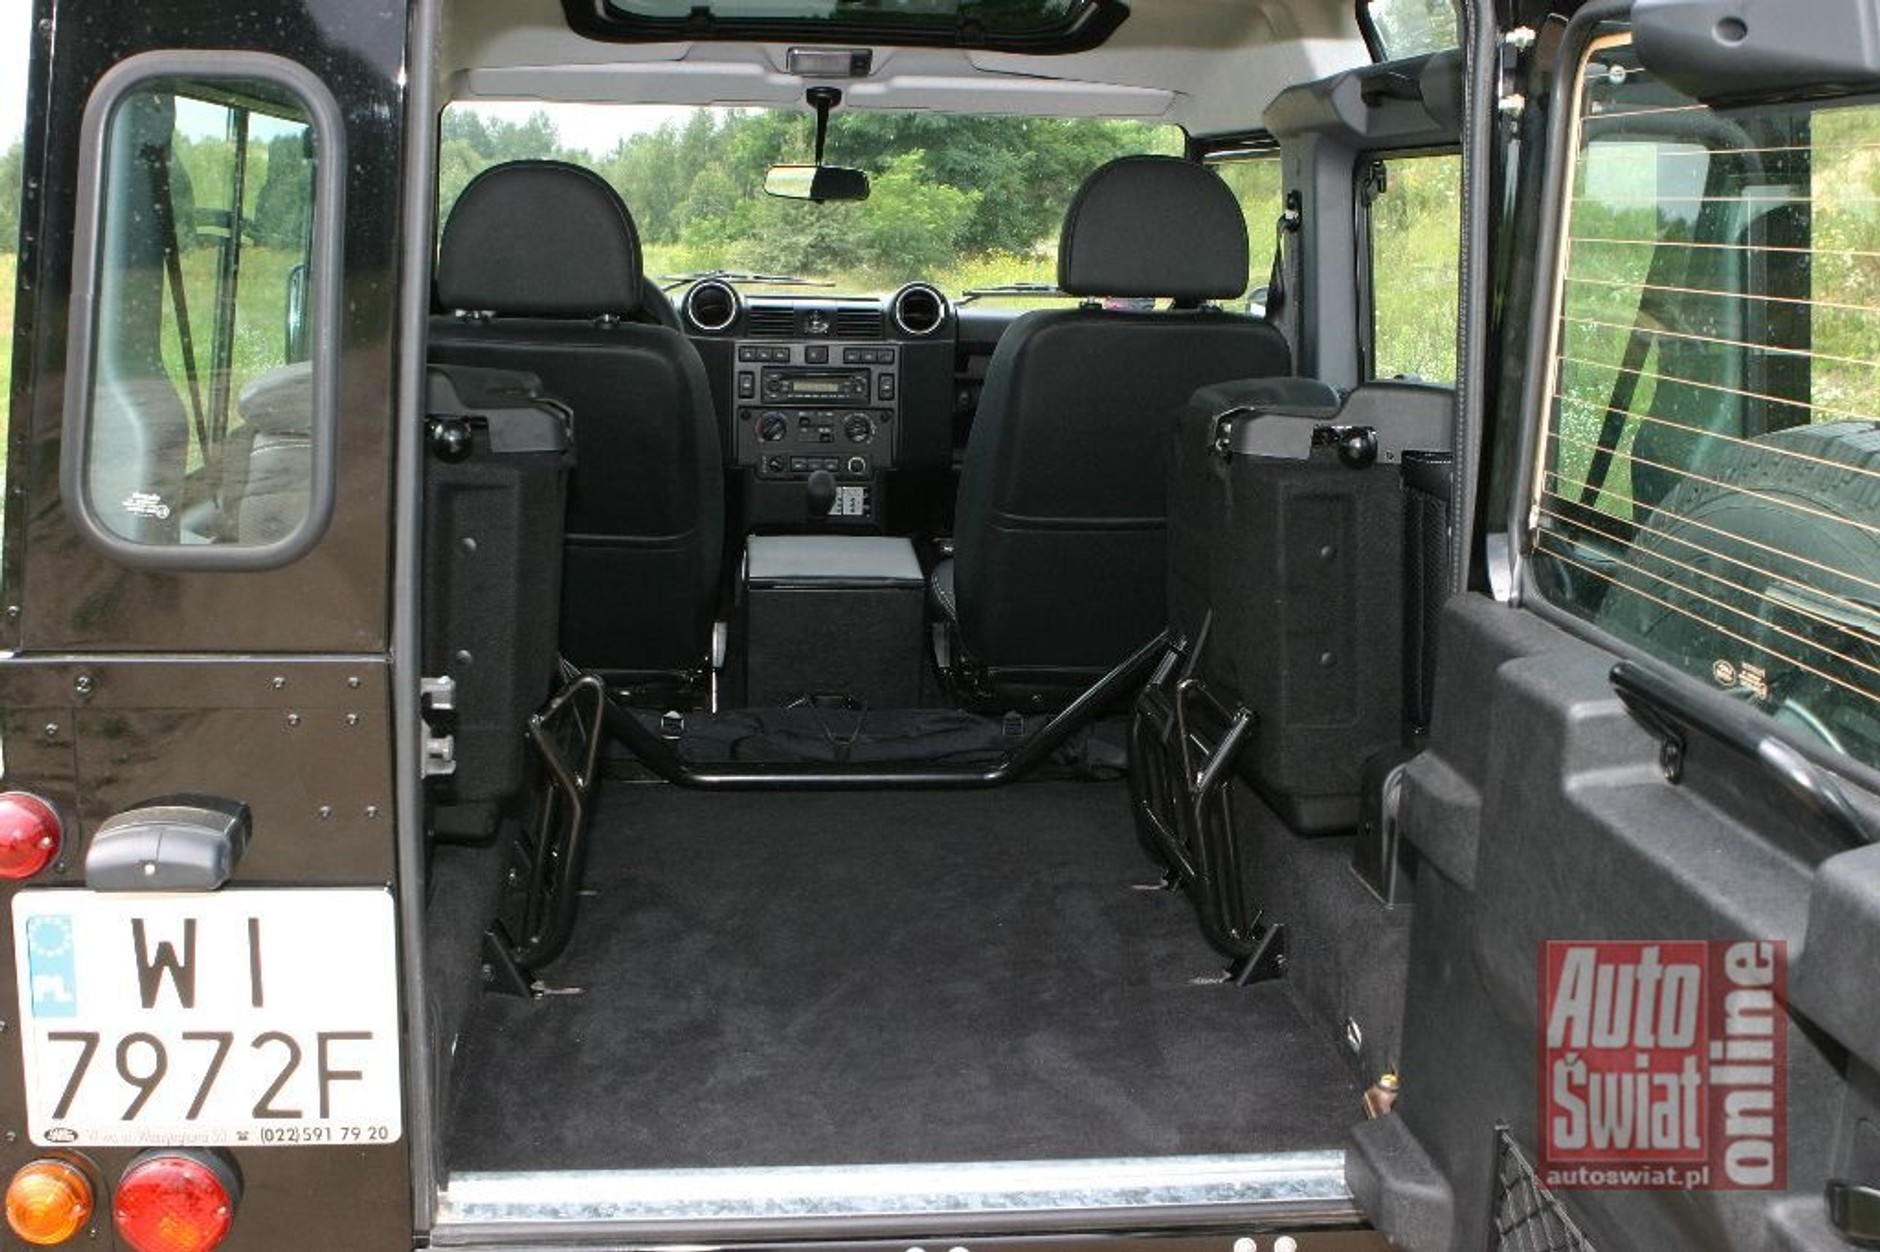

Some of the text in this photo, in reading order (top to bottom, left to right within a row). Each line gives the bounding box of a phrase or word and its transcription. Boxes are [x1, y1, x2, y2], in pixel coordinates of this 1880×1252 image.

[131, 917, 264, 1009] W I
[48, 1030, 373, 1121] 7972F
[260, 1125, 389, 1144] (022) 591 79 20
